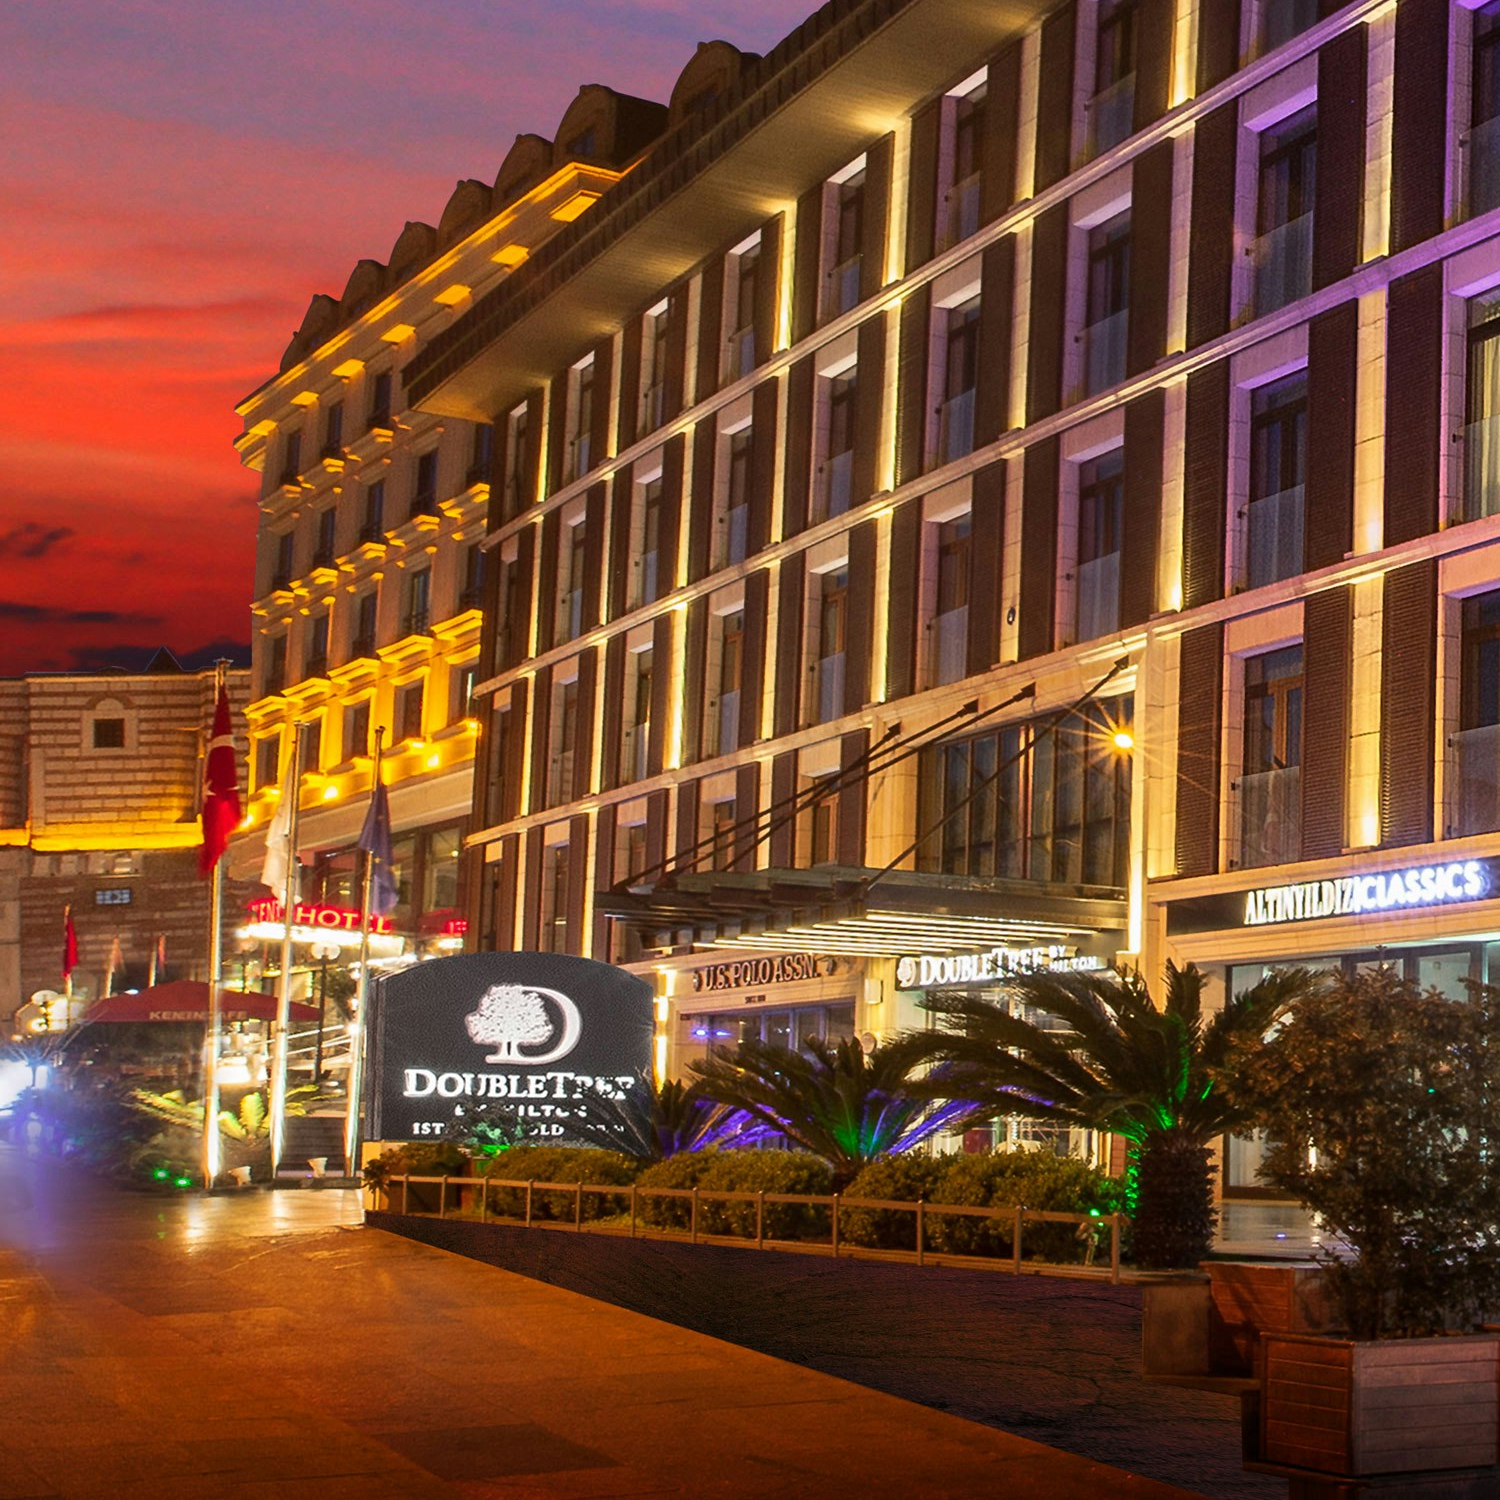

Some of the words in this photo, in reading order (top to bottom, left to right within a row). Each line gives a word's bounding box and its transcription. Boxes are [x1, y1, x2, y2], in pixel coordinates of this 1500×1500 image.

[294, 906, 392, 934] HOTL
[704, 965, 730, 991] U.S.
[731, 959, 771, 988] POLO
[772, 953, 820, 983] ASSN.
